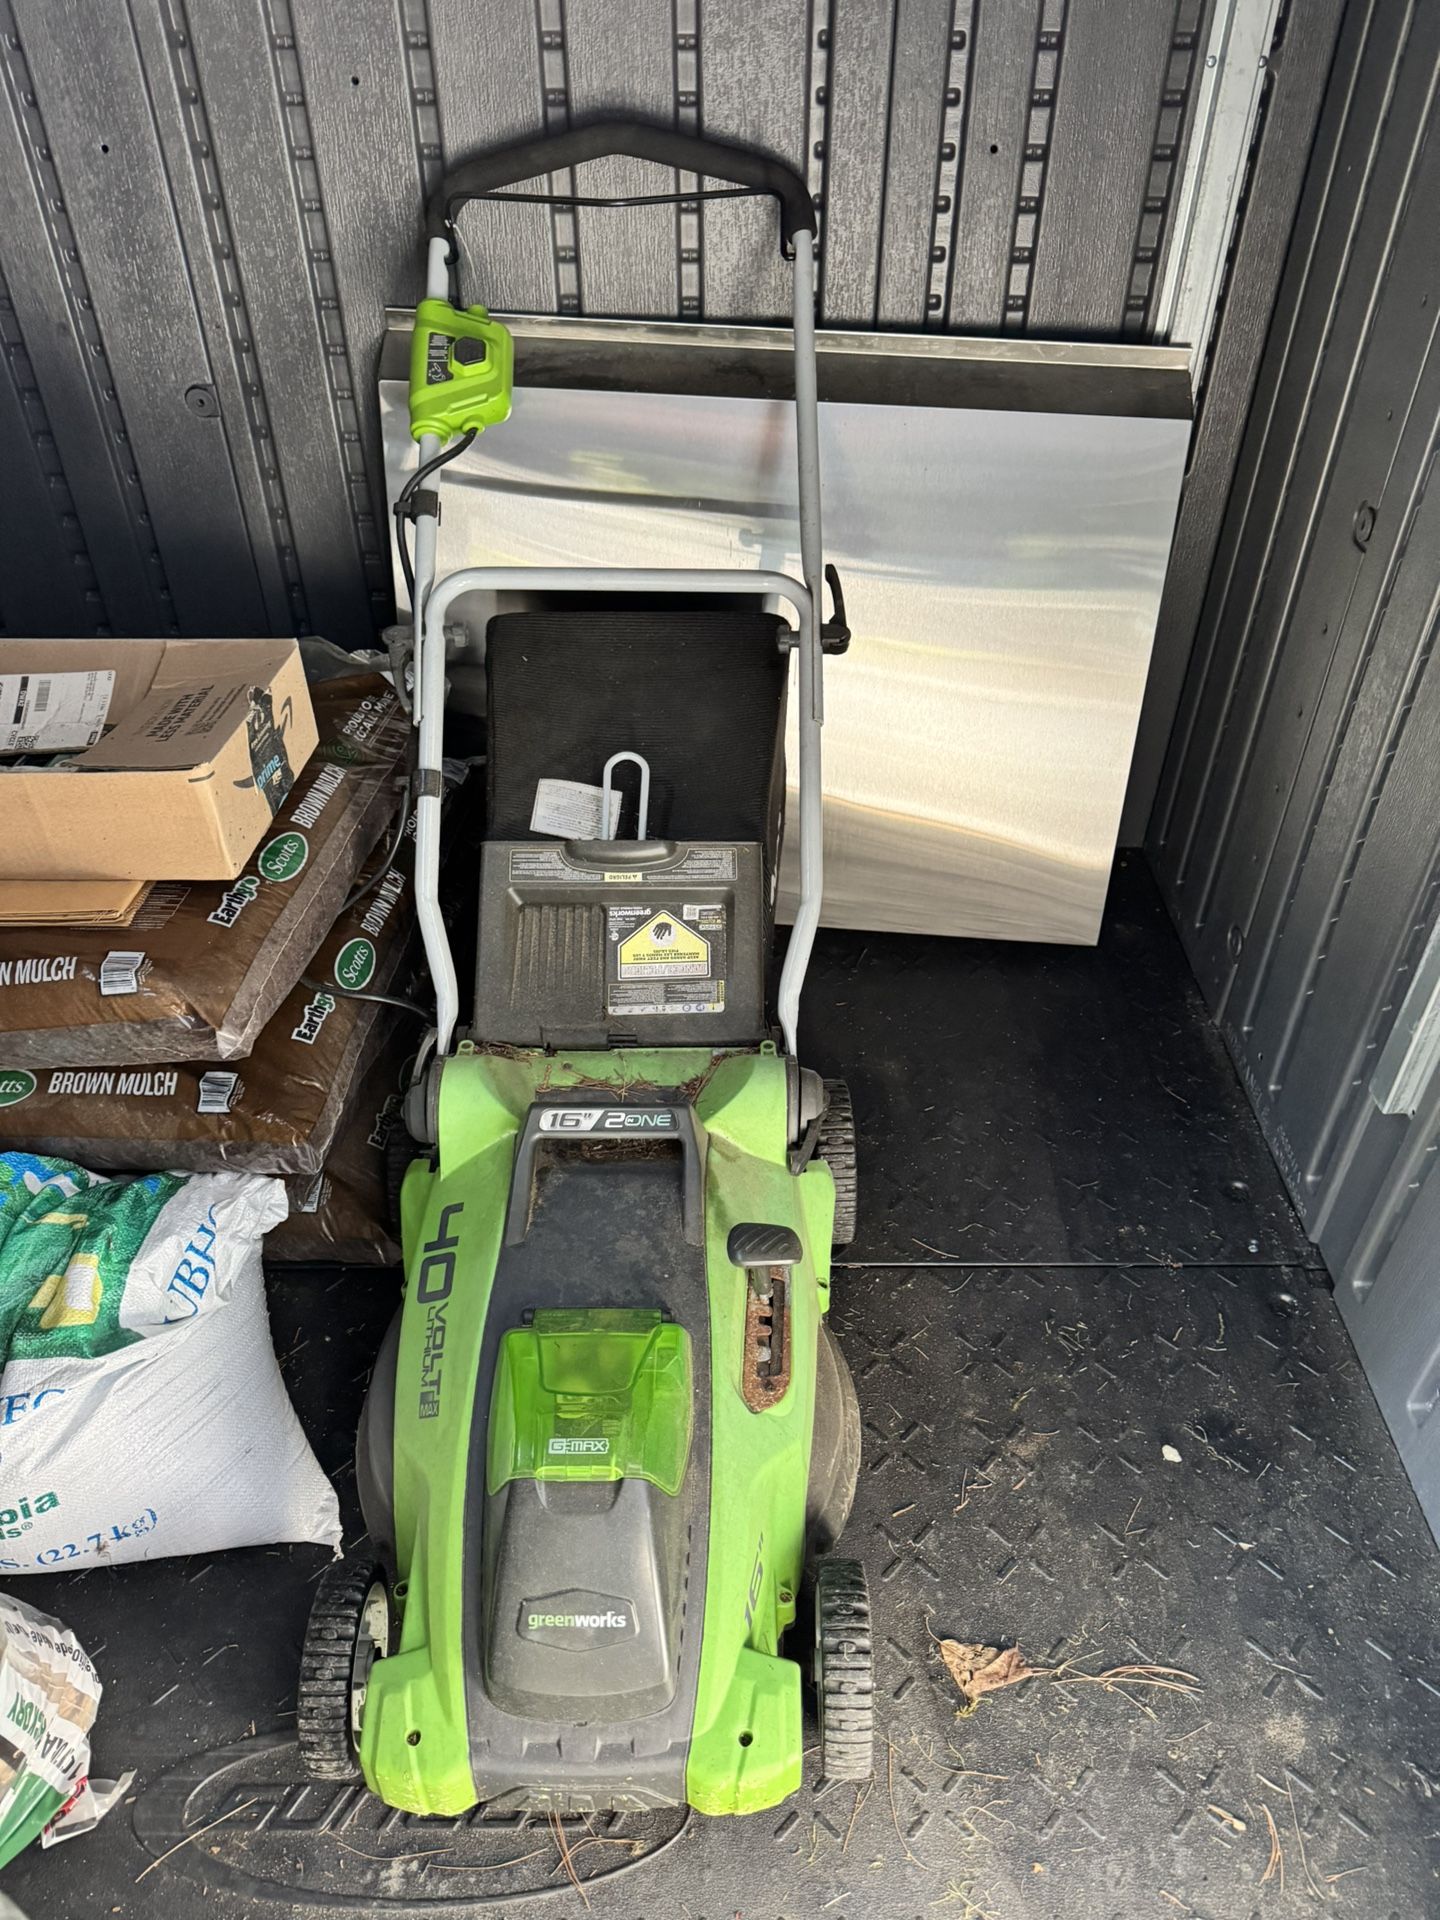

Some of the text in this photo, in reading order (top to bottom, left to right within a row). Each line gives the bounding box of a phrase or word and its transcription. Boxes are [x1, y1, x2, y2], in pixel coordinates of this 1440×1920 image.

[146, 714, 175, 737] MADE
[168, 693, 195, 715] WITH
[155, 685, 215, 742] LESS MATERIAL
[257, 755, 281, 789] prime
[289, 762, 347, 828] BROWN MULCH
[266, 839, 299, 875] Scotts
[207, 876, 260, 928] Earthgro
[15, 957, 77, 984] MULCH
[342, 945, 370, 983] Scotts
[292, 992, 335, 1045] Earthgr
[48, 1072, 178, 1096] BROWN MULCH
[550, 1112, 593, 1128] 16"
[417, 1202, 464, 1304] 40
[421, 1306, 436, 1387] LITHIUM
[429, 1301, 449, 1395] VOLT
[420, 1403, 439, 1418] MAX
[110, 1508, 158, 1542] kg)
[528, 1611, 627, 1630] greenworks
